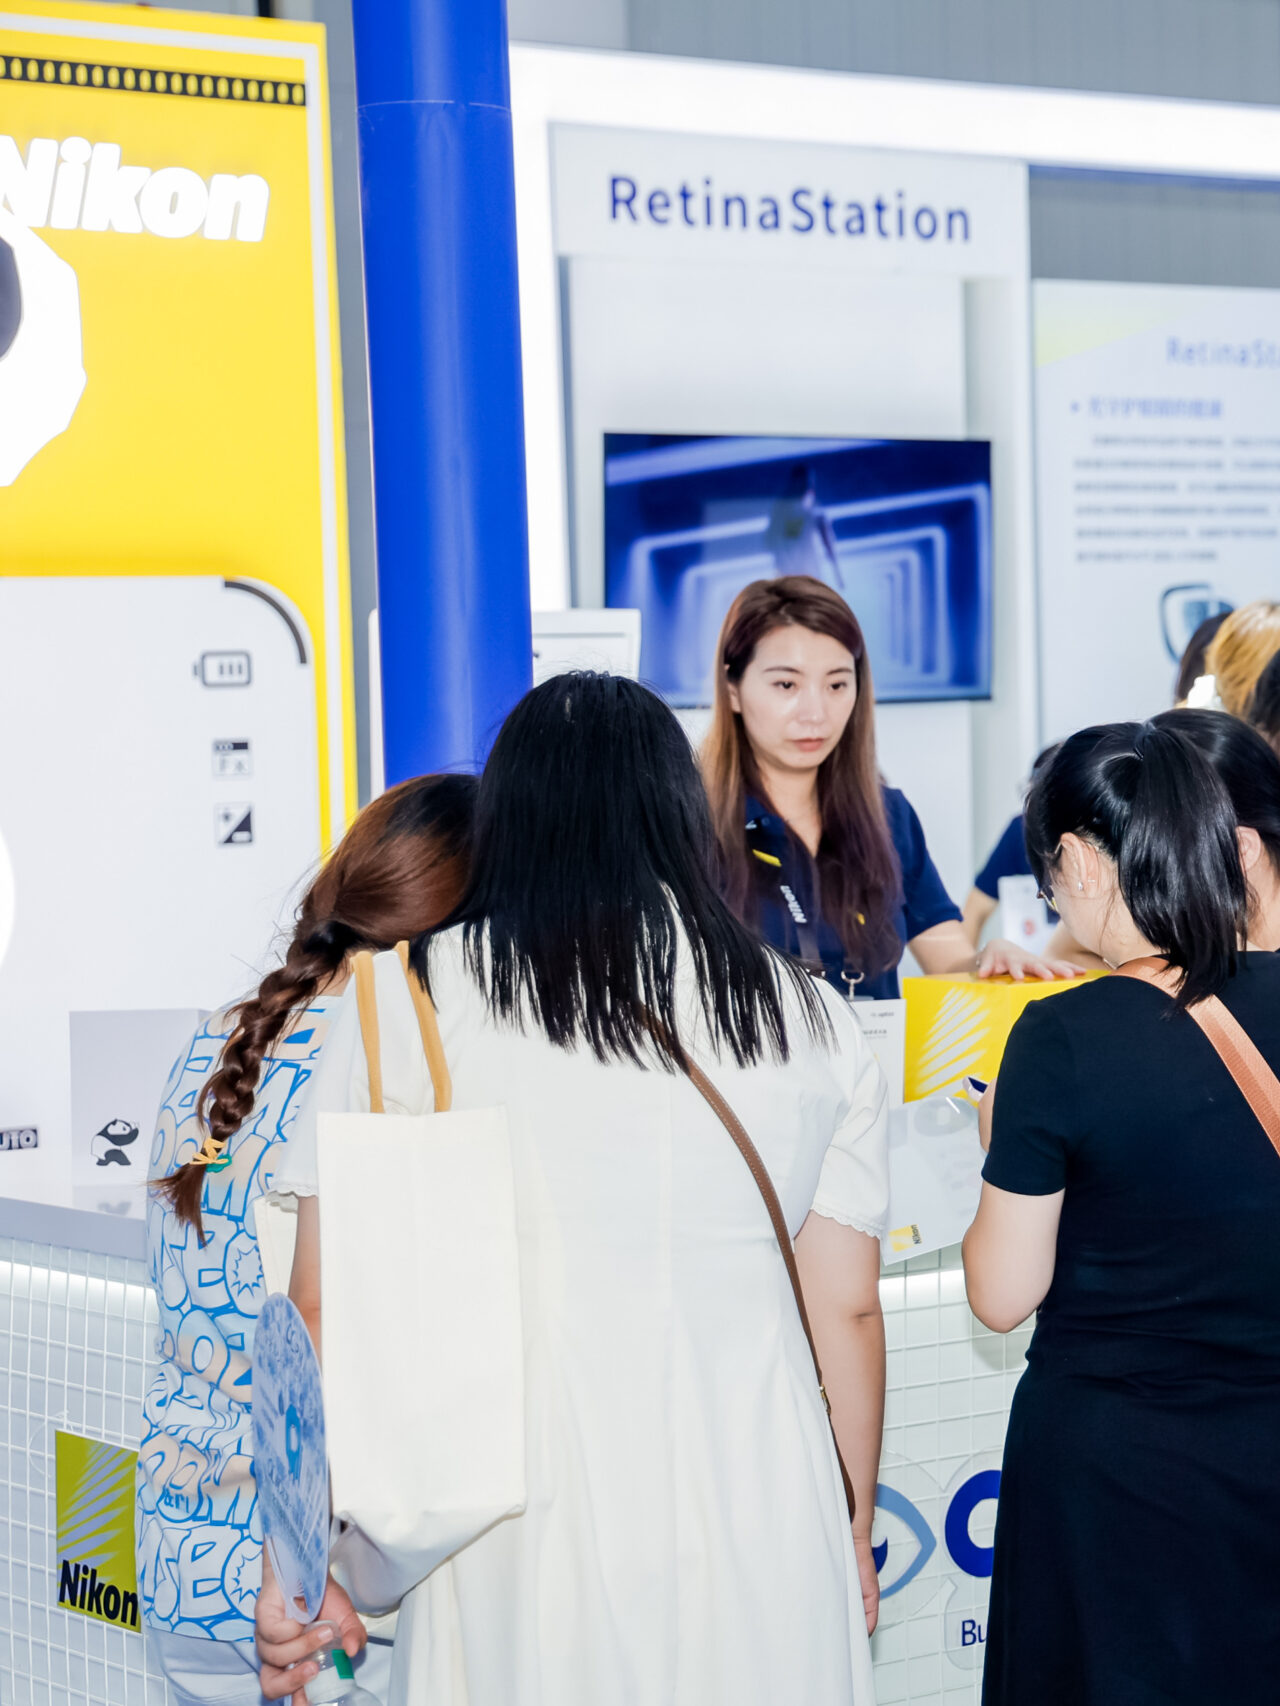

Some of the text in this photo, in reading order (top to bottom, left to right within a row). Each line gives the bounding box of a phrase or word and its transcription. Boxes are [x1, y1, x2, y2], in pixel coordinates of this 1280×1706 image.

[0, 134, 270, 242] Nikon
[609, 174, 972, 243] RetinaStation
[58, 1559, 139, 1627] Nikon
